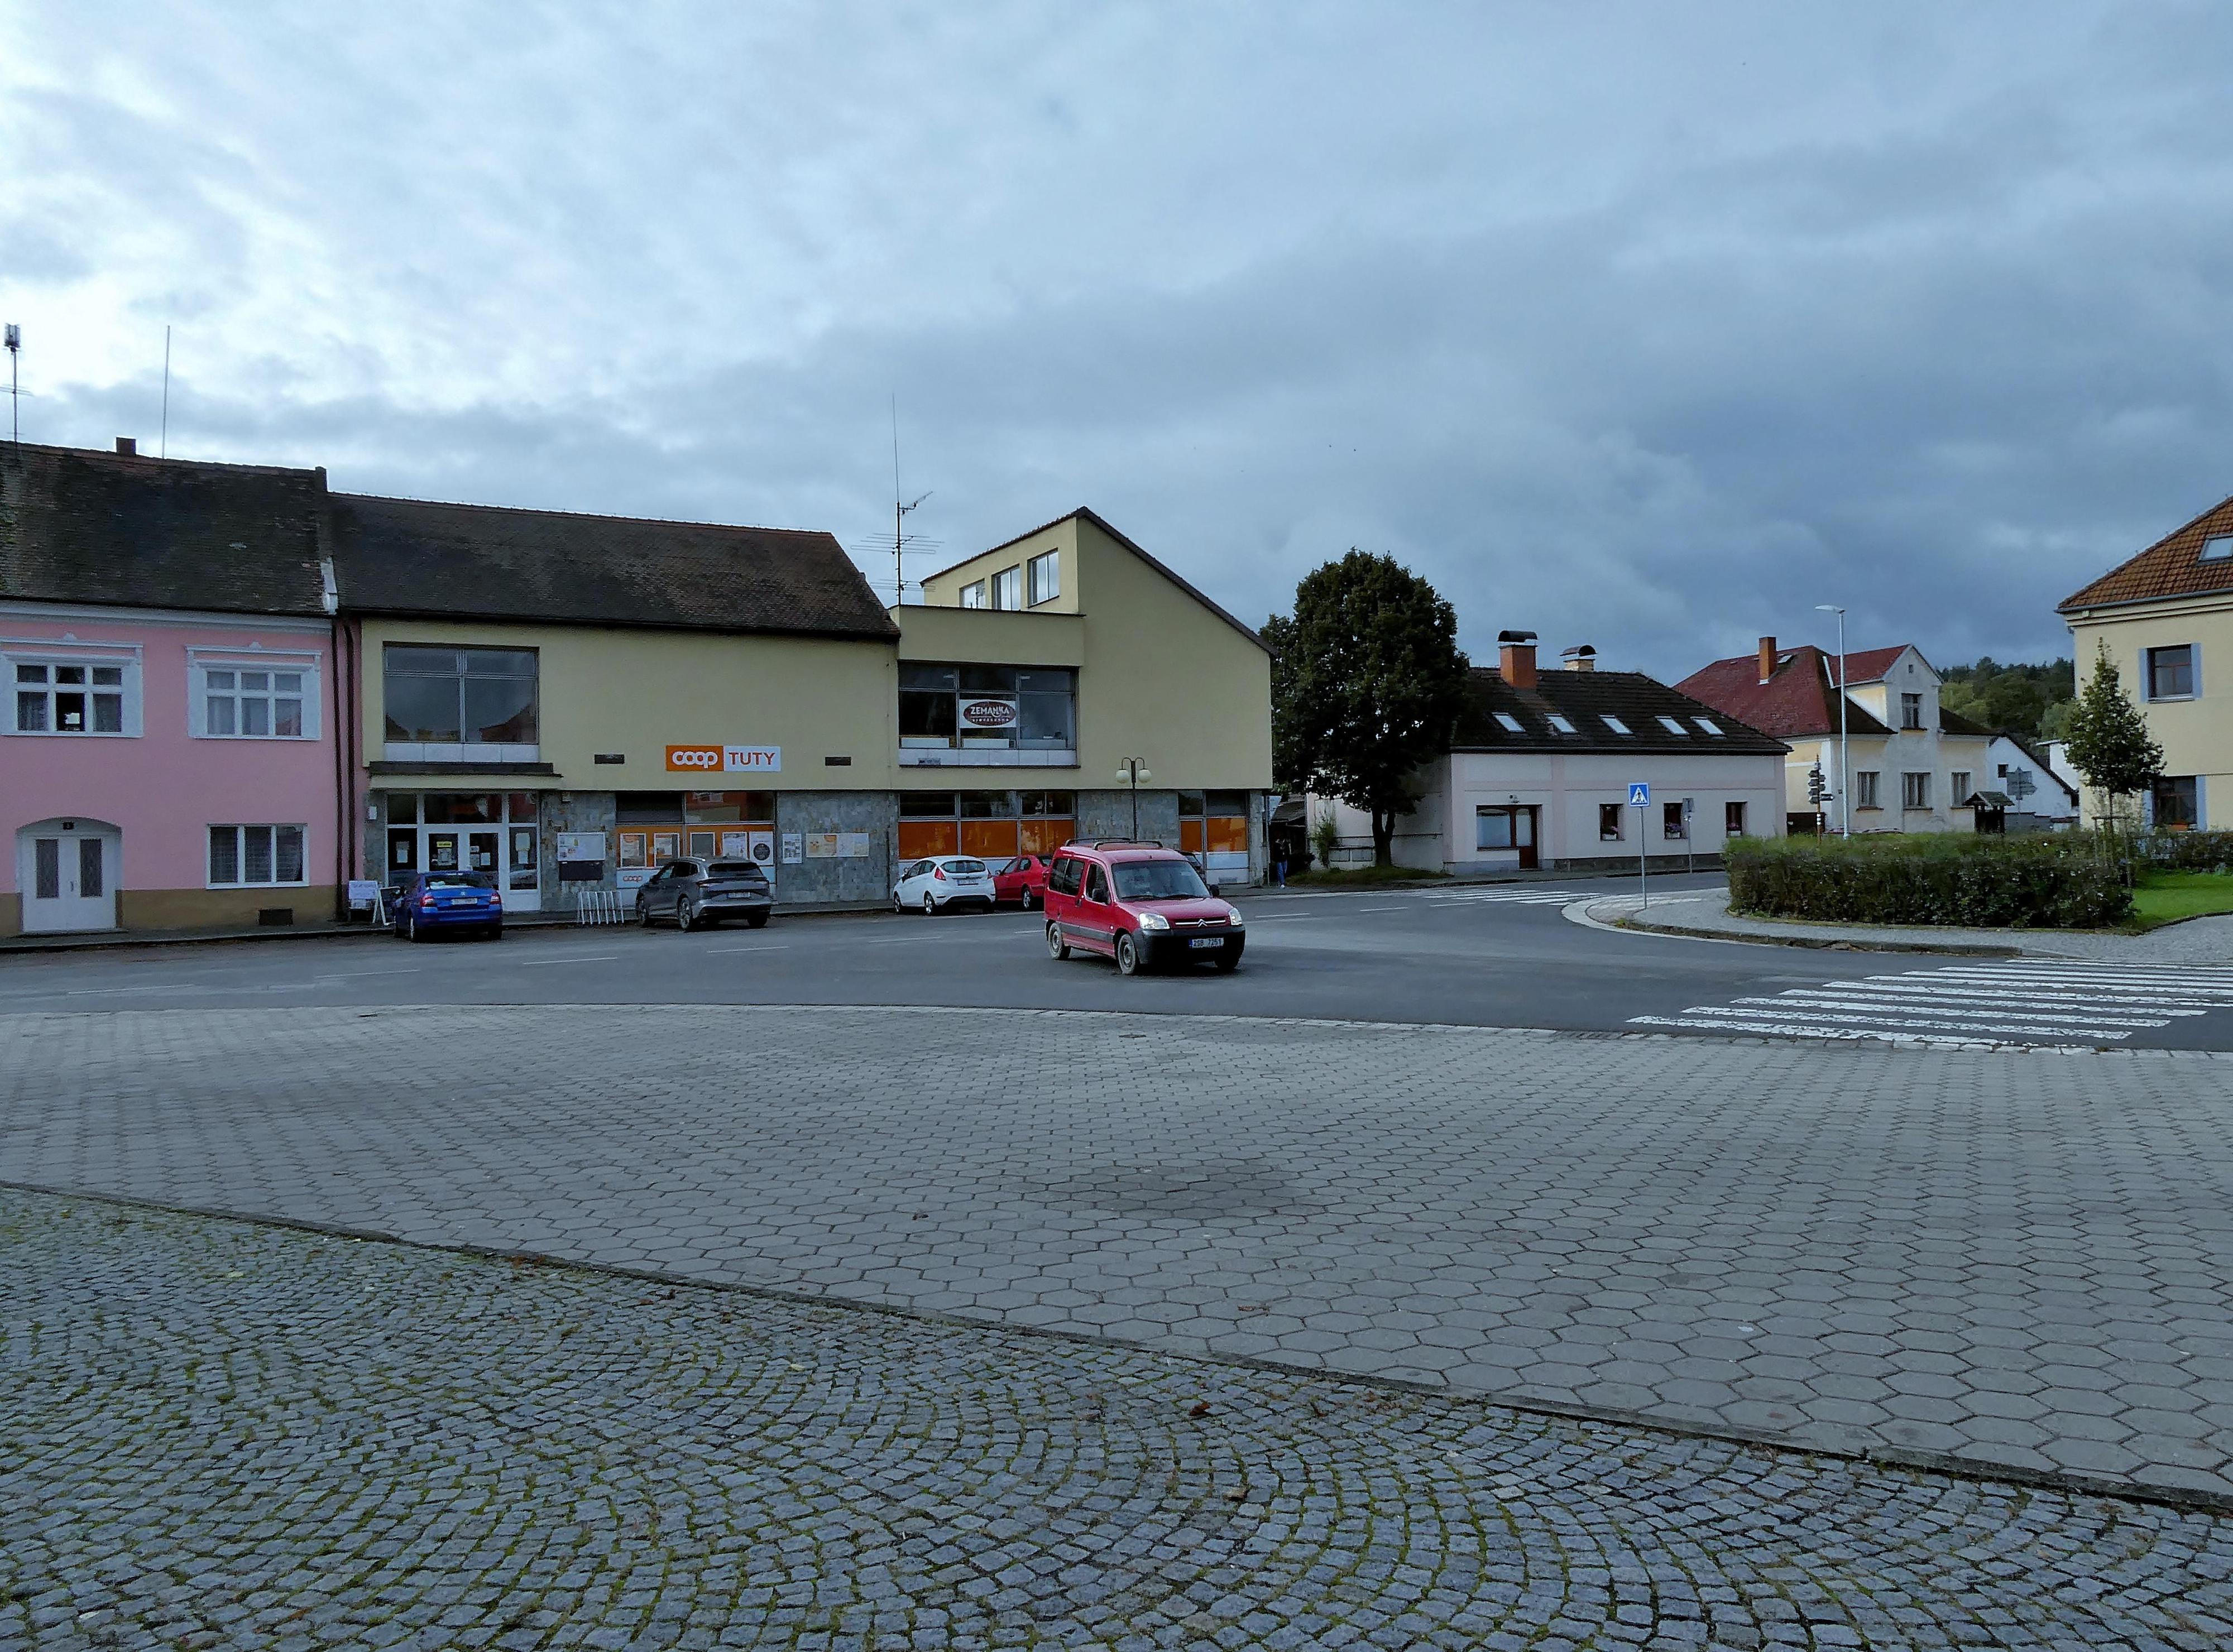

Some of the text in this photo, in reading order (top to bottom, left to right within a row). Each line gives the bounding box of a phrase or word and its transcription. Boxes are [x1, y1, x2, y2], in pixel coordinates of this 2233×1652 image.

[970, 705, 1009, 717] ZEMANKA
[672, 751, 775, 769] coop TUTY
